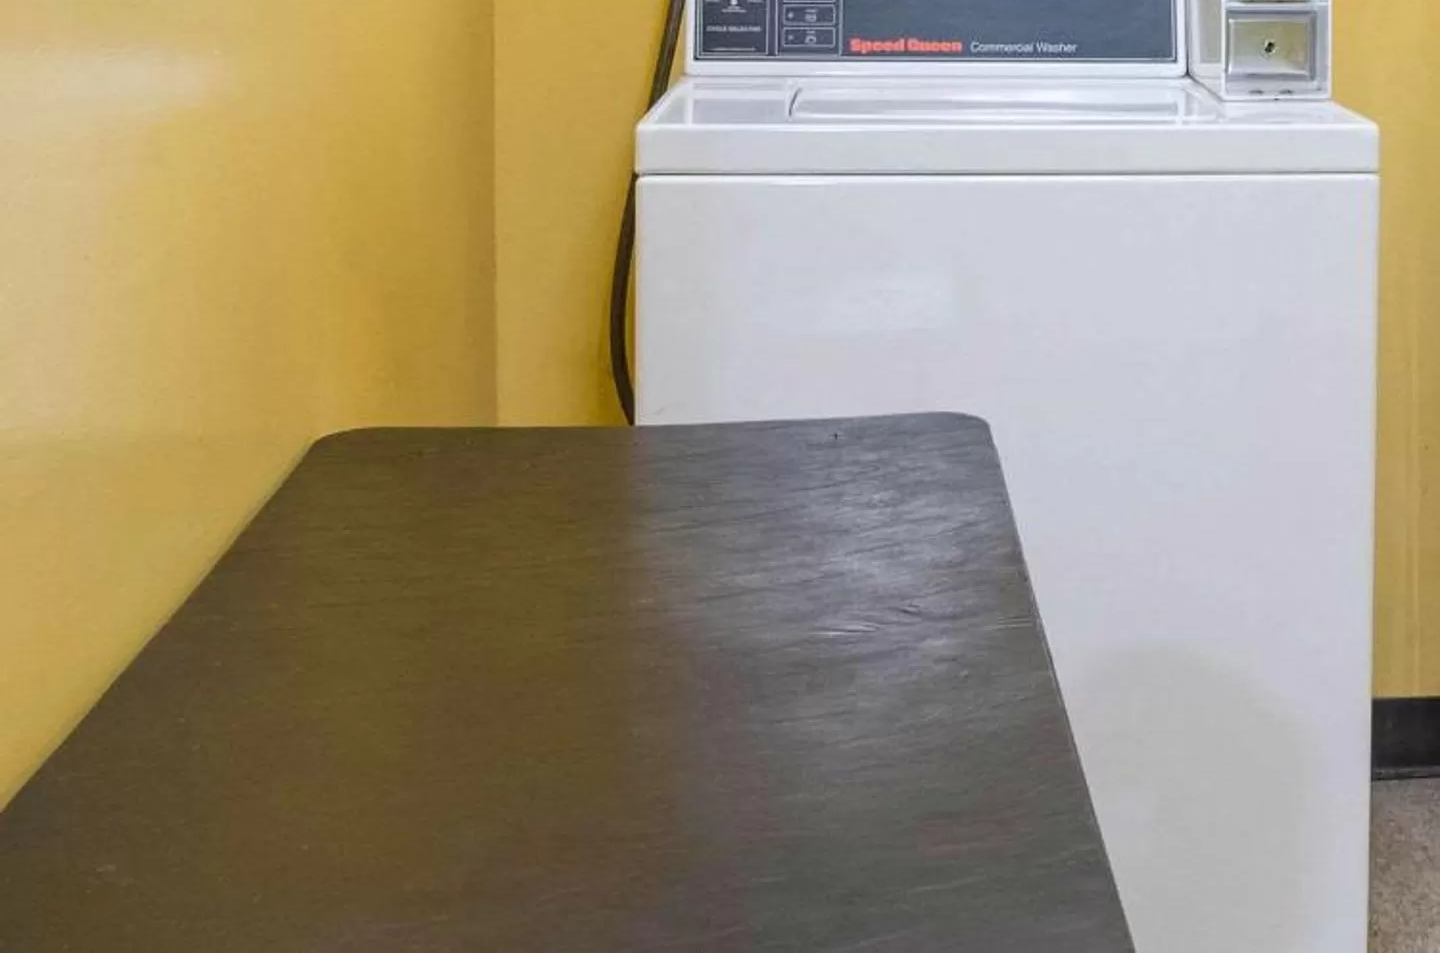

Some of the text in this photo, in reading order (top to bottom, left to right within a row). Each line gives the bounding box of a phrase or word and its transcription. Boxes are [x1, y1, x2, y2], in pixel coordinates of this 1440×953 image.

[850, 37, 1079, 54] Speed Queen Commercial Washer
